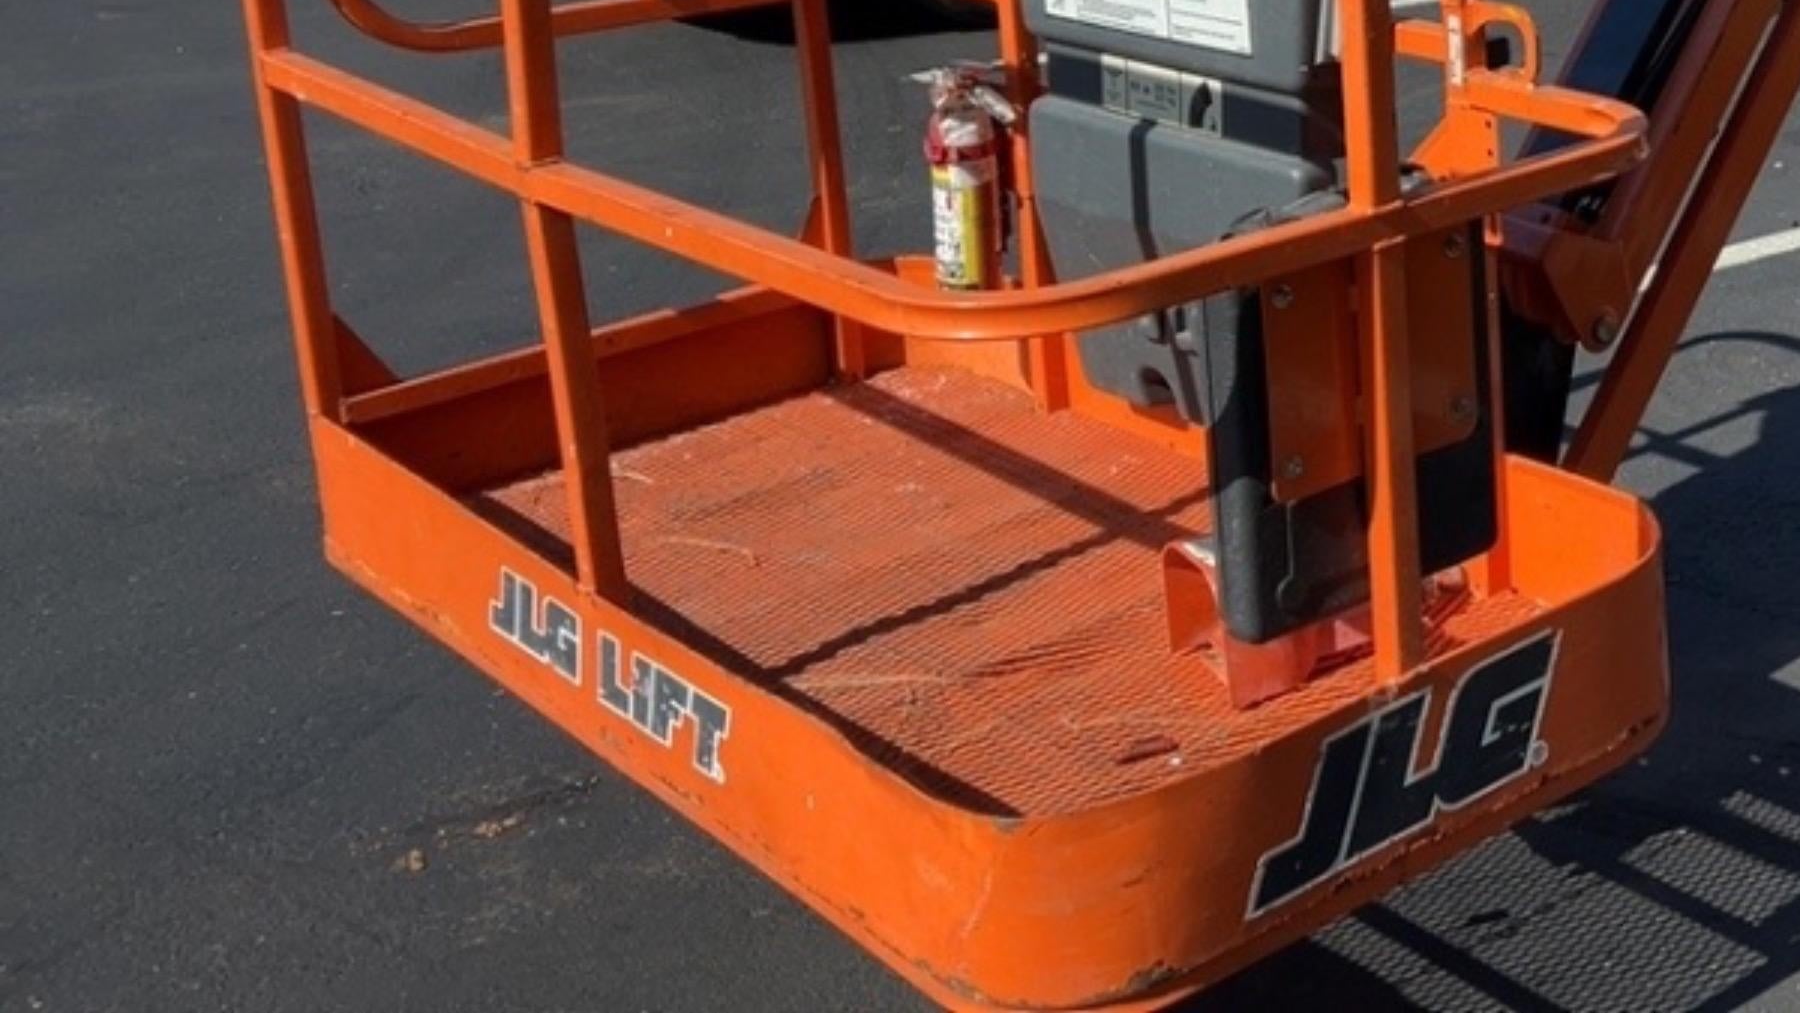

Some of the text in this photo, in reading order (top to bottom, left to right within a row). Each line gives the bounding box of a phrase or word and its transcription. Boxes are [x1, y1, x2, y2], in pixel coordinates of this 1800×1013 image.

[489, 565, 732, 785] JLG LIFT
[1244, 627, 1564, 921] JLG
